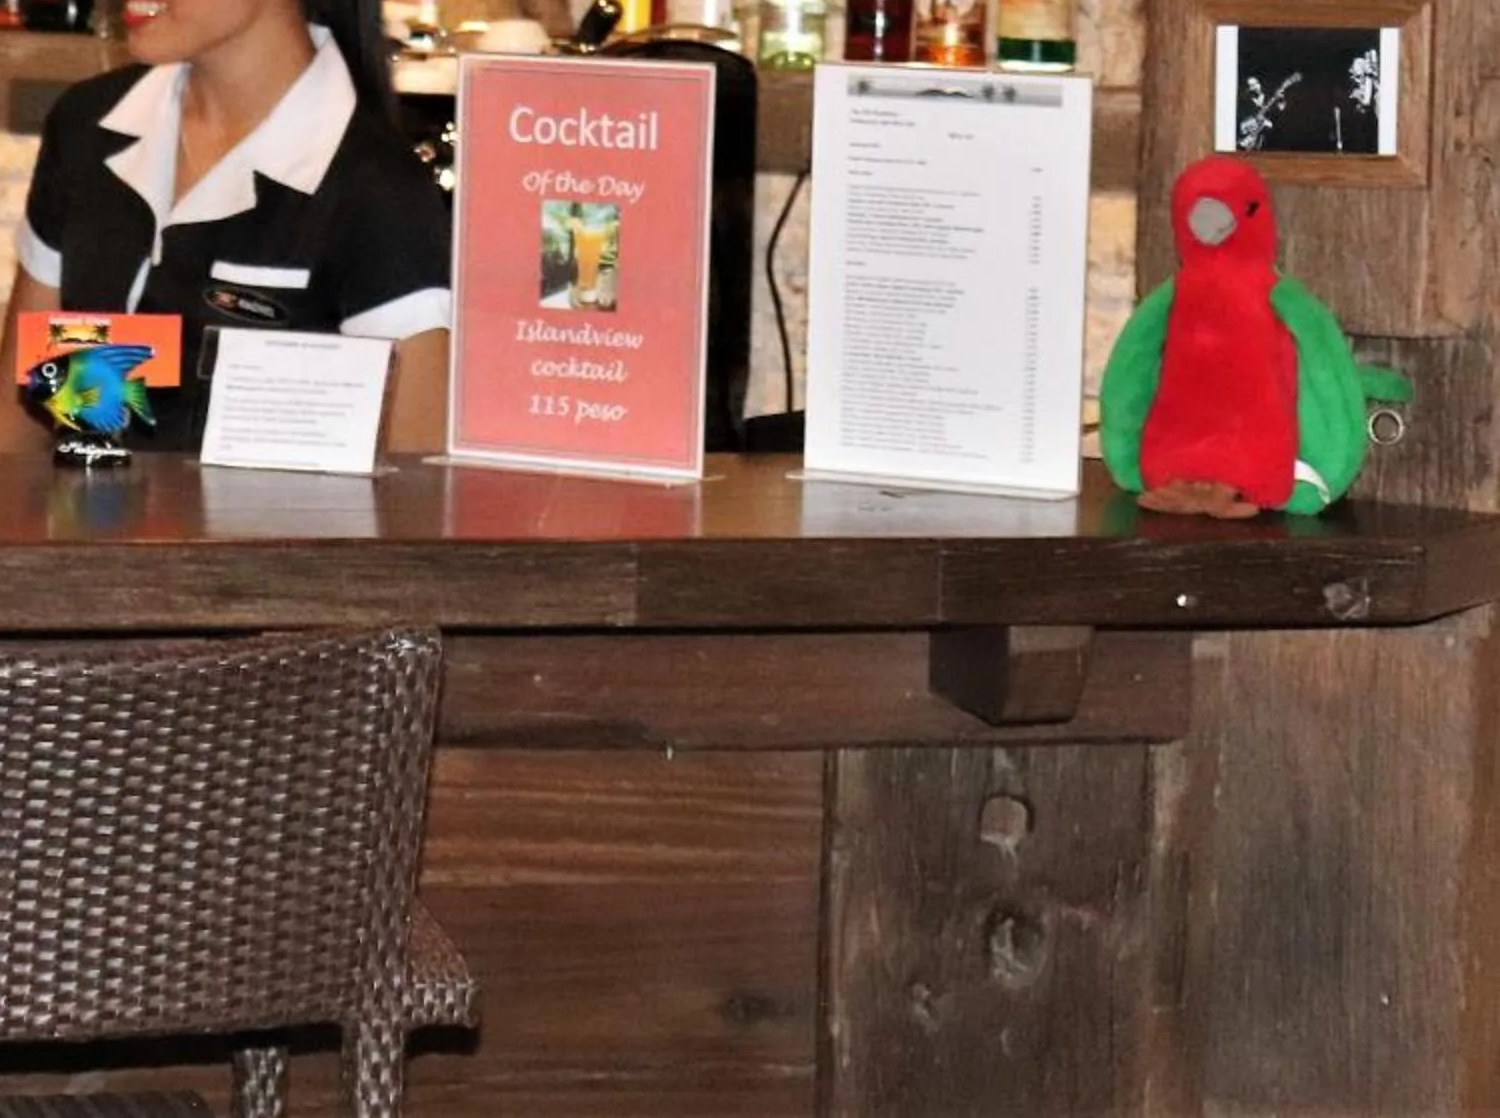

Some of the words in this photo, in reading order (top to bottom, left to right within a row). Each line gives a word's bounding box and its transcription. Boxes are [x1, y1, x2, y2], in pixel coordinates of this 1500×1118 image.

[508, 105, 658, 151] Cocktail
[554, 170, 595, 195] the
[597, 174, 646, 204] Day
[515, 318, 645, 350] Islandview
[530, 356, 629, 384] cocktail
[529, 393, 570, 417] 115
[573, 398, 629, 425] peso
